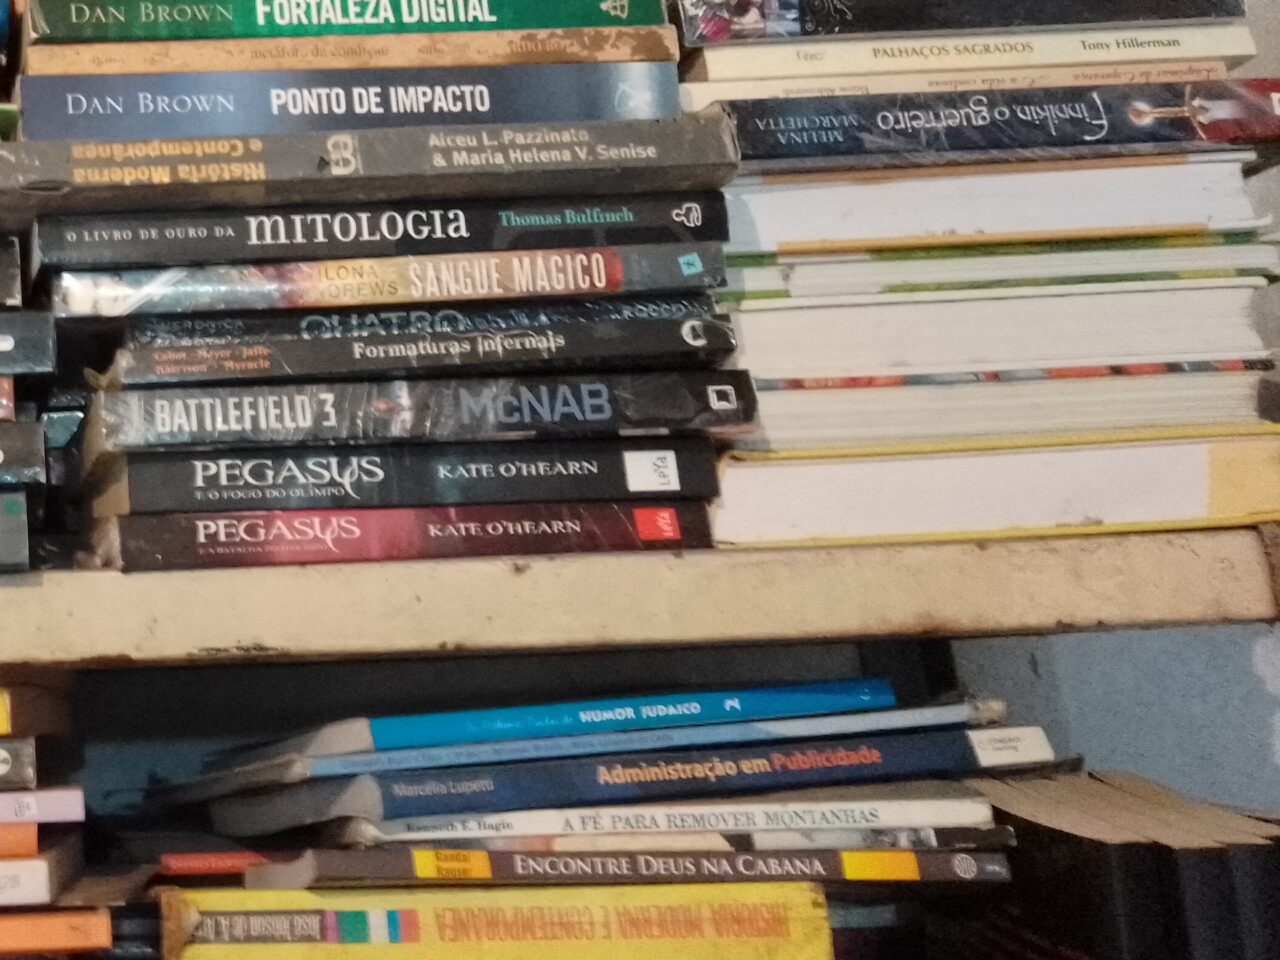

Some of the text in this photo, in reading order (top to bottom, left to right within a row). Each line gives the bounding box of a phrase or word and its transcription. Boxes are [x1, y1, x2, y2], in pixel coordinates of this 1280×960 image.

[70, 2, 127, 24] DAN
[140, 0, 235, 23] BROWN
[872, 36, 1181, 60] PALHAÇOS SAGRADOS Tony Hillerman
[66, 84, 490, 116] DAN BROWN PONTO DE IMPACTO
[876, 94, 1010, 131] o guerreiro
[755, 113, 858, 131] MARCHETTA
[428, 131, 478, 149] Alceu
[502, 128, 590, 146] Pazzinato
[776, 128, 845, 144] MELINA
[72, 139, 263, 161] e Contemporânea
[433, 142, 657, 168] & Maria Helena V. Senise
[72, 162, 267, 186] História Moderna
[83, 228, 132, 242] LIVRO
[139, 227, 160, 241] DE
[165, 226, 208, 240] OURO
[214, 225, 235, 239] DA
[497, 209, 562, 228] Thomas
[565, 206, 635, 225] Bulfinch
[408, 248, 608, 296] SANGUE MÁGICO
[352, 330, 567, 362] Formaturas Infernais
[154, 394, 313, 433] BATTLEFIELD
[318, 392, 337, 428] 3
[191, 455, 599, 499] PEGASUS KATE O'HEARN
[195, 515, 362, 552] PEGASUS
[427, 522, 484, 539] KATE
[485, 518, 582, 538] O'HEARN
[596, 744, 882, 786] Administração em Publicidade
[562, 807, 881, 832] A FÉ PARA REMOVER MONTANHAS
[513, 853, 827, 876] ENCONTRE DEUS NA CABANA
